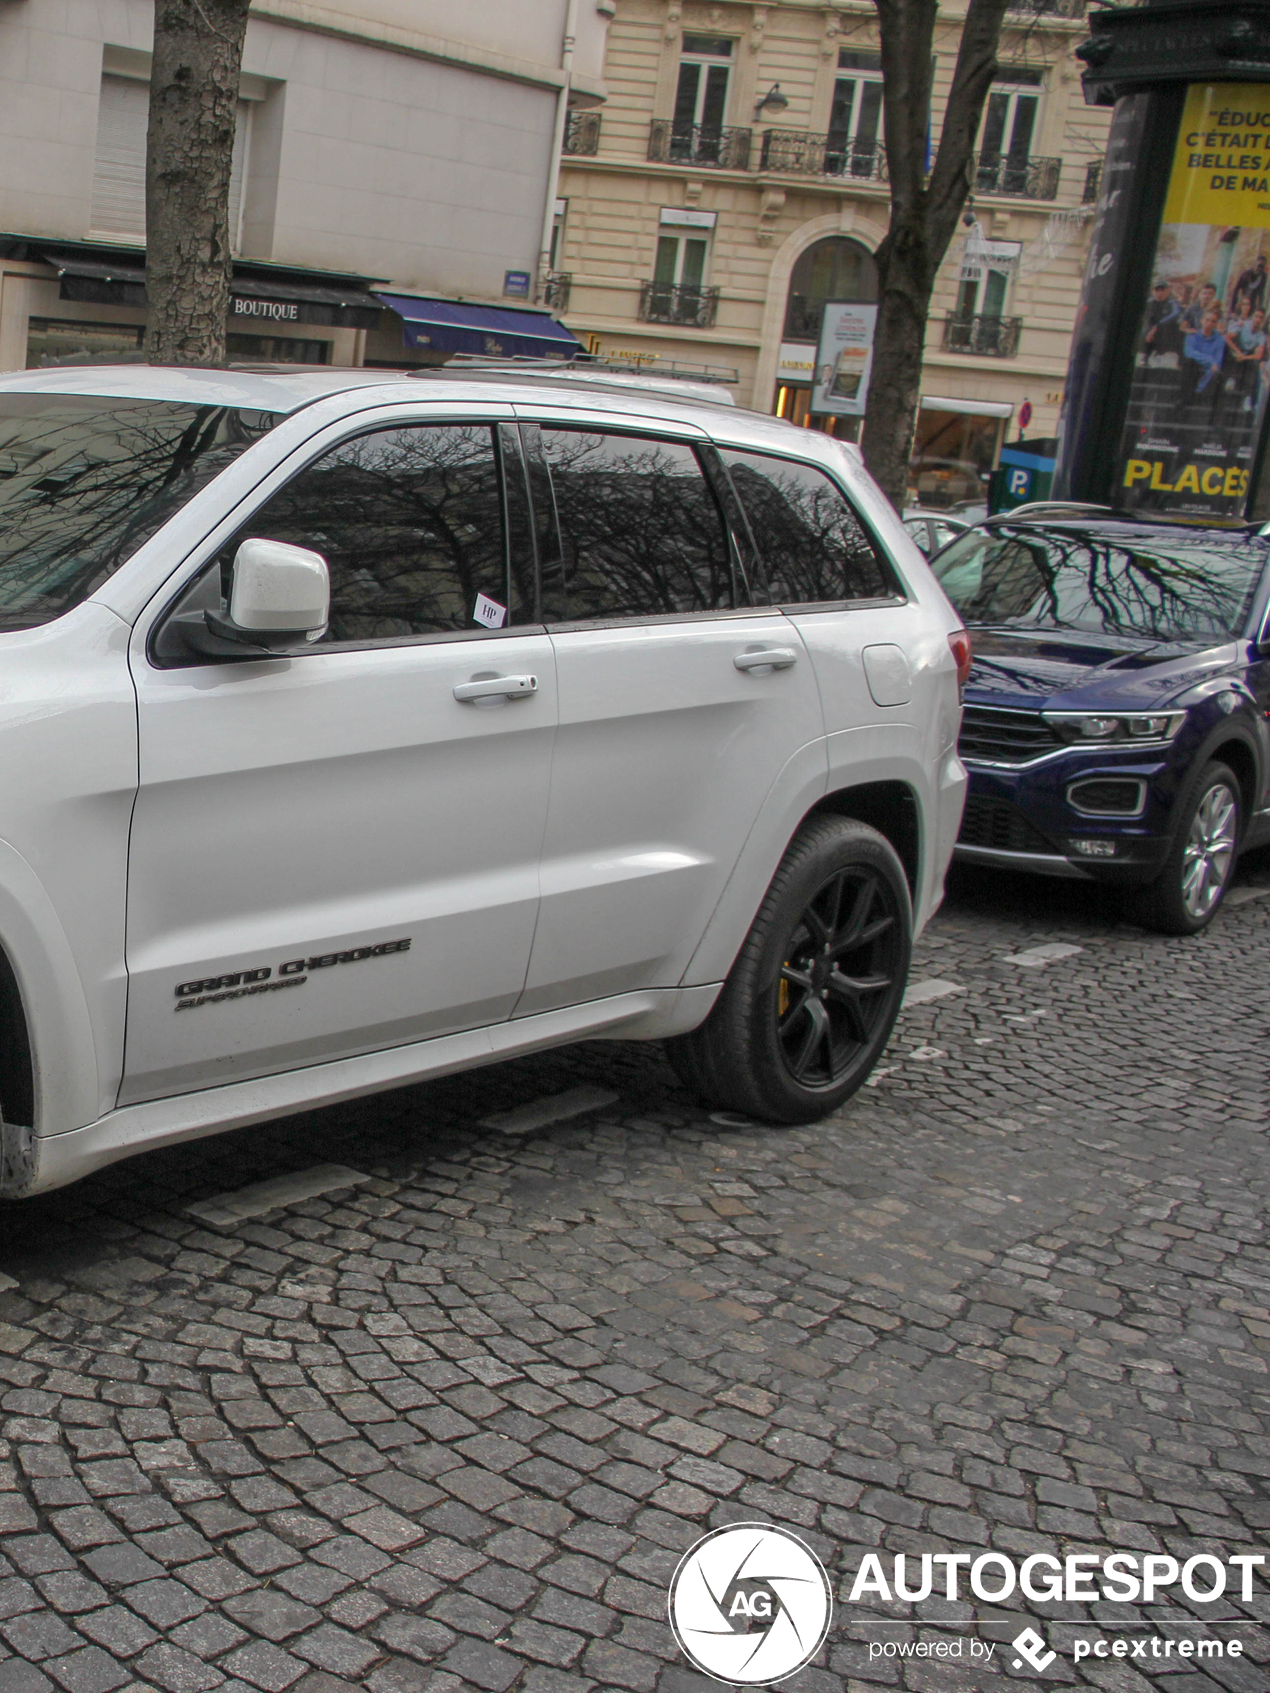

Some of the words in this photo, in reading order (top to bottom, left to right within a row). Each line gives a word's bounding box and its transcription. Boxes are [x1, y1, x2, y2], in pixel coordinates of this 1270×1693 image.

[1186, 129, 1263, 149] C'ÉTAIT
[1188, 152, 1262, 170] BELLES
[1210, 175, 1238, 191] DE
[1241, 176, 1269, 192] MA
[234, 298, 298, 321] BOUTIQUE
[1011, 470, 1028, 493] P
[1123, 459, 1250, 497] PLACÉS
[482, 604, 497, 619] HP
[175, 966, 272, 997] GRAND
[280, 938, 412, 976] CHEROKEE
[174, 975, 307, 1012] SUPERCHARGED
